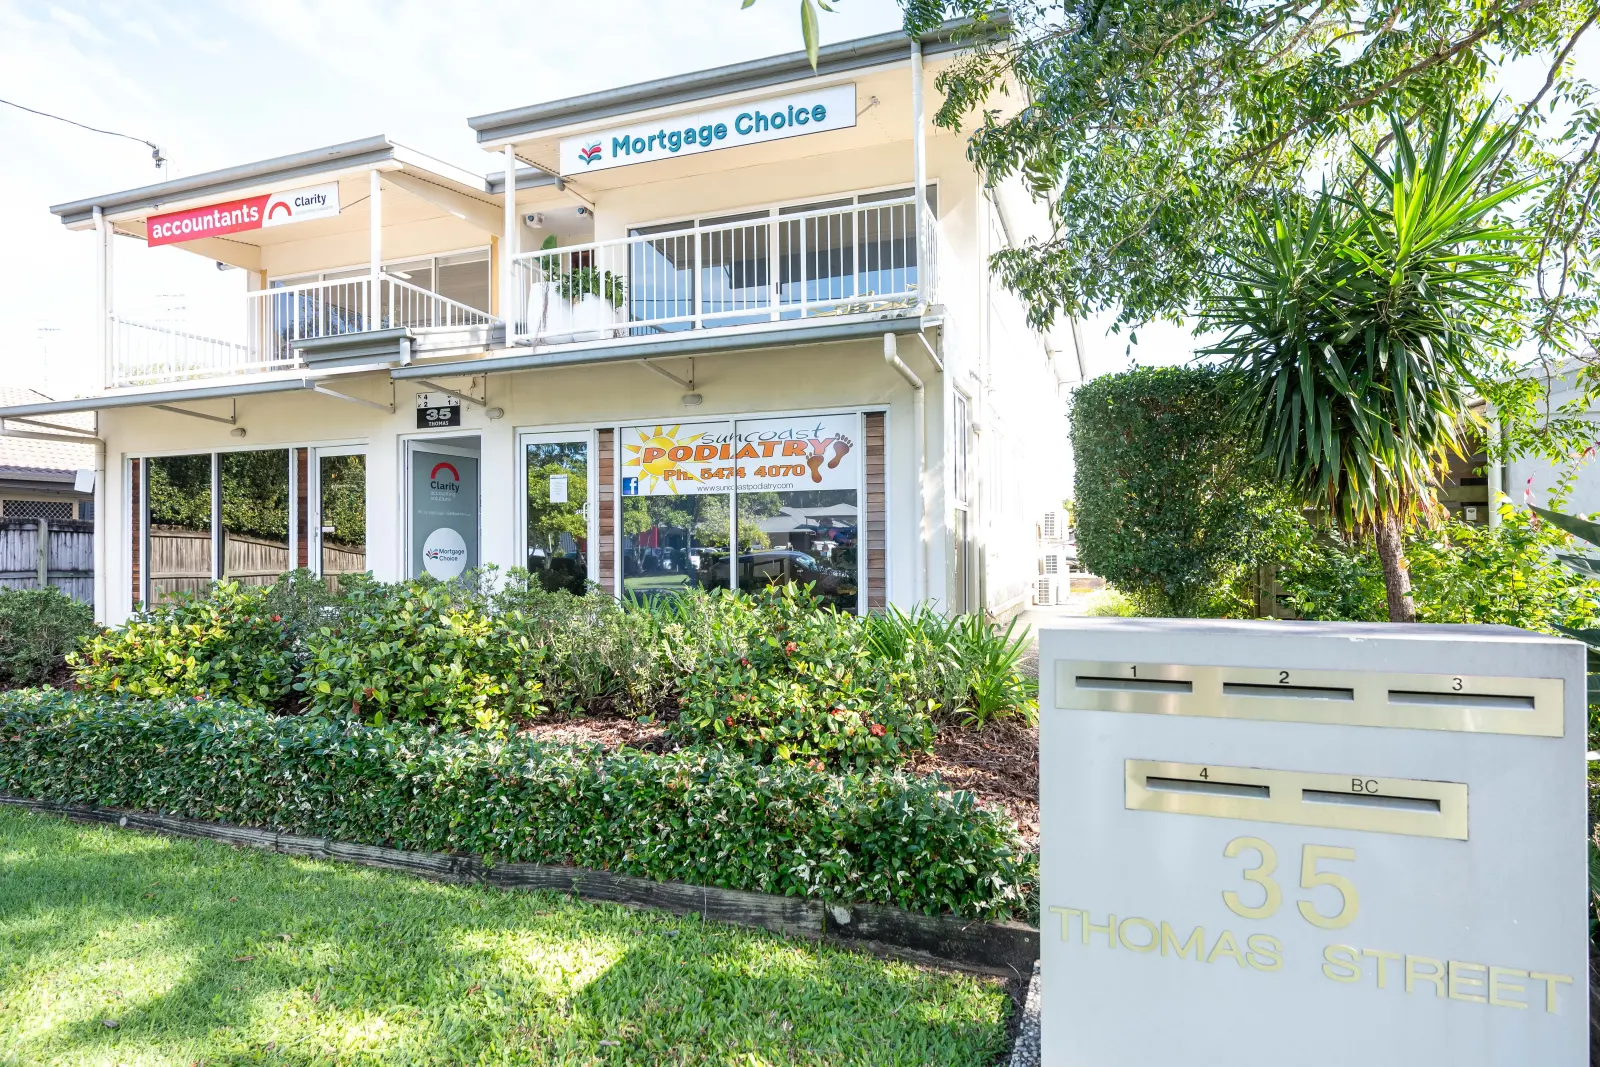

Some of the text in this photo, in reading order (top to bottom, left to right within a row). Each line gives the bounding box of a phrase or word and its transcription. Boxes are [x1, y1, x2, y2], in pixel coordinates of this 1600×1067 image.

[612, 104, 827, 157] Mortgage Choice
[294, 193, 327, 207] Clarity
[152, 204, 259, 239] accountants
[425, 408, 452, 421] 35
[701, 422, 826, 444] suncoast
[643, 438, 836, 463] PODIATRY
[664, 464, 805, 481] Ph. 5474 4070
[430, 481, 460, 493] Clarity
[438, 548, 465, 556] Mortgage
[1129, 665, 1138, 677] 1
[1278, 671, 1290, 684] 2
[1451, 678, 1463, 691] 3
[1199, 768, 1209, 780] 4
[1351, 779, 1379, 794] BC
[1222, 836, 1360, 930] 35
[1049, 906, 1573, 1014] THOMAS STREET
